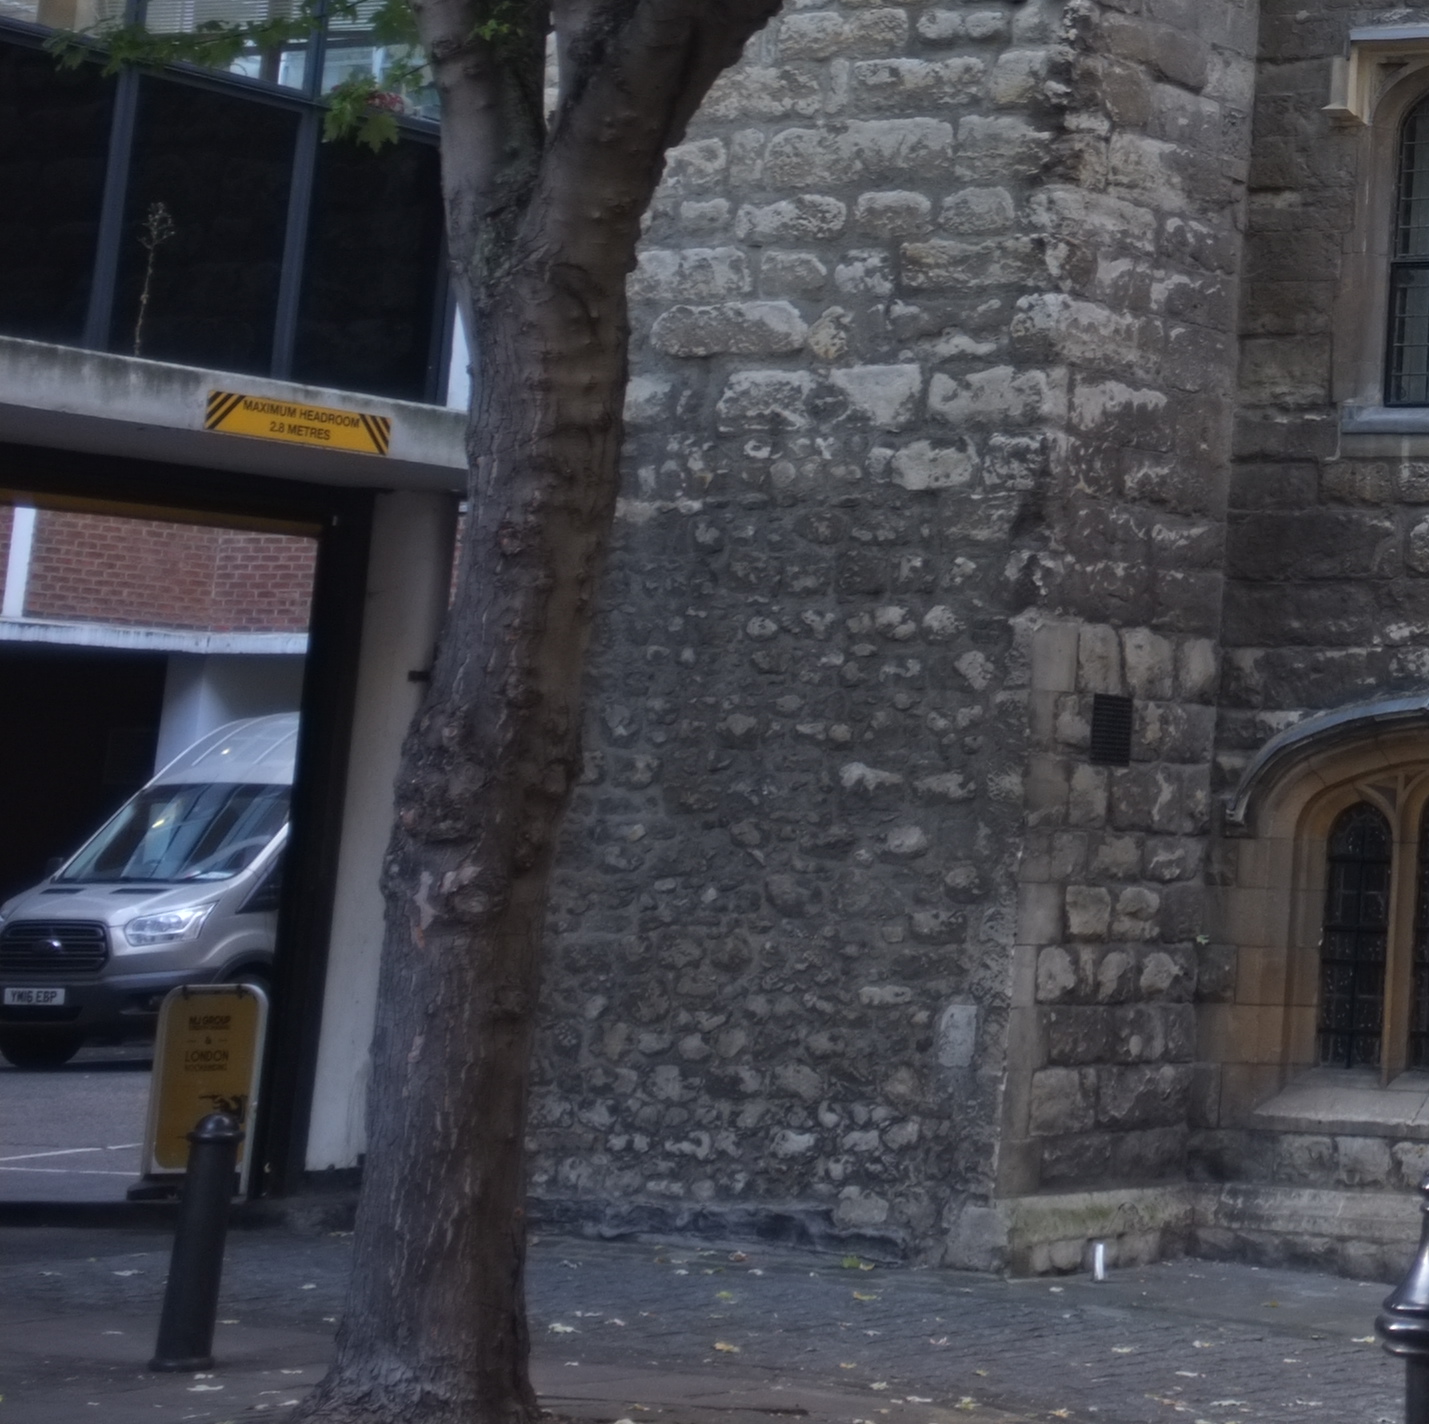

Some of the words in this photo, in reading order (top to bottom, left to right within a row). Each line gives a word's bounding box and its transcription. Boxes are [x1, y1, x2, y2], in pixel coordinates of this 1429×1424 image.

[243, 399, 297, 418] MAXIMUM
[299, 409, 360, 429] HEADROOM
[270, 421, 285, 434] 2.8
[288, 424, 331, 440] METRES
[36, 990, 57, 1003] EBP
[185, 1050, 229, 1062] LONDON
